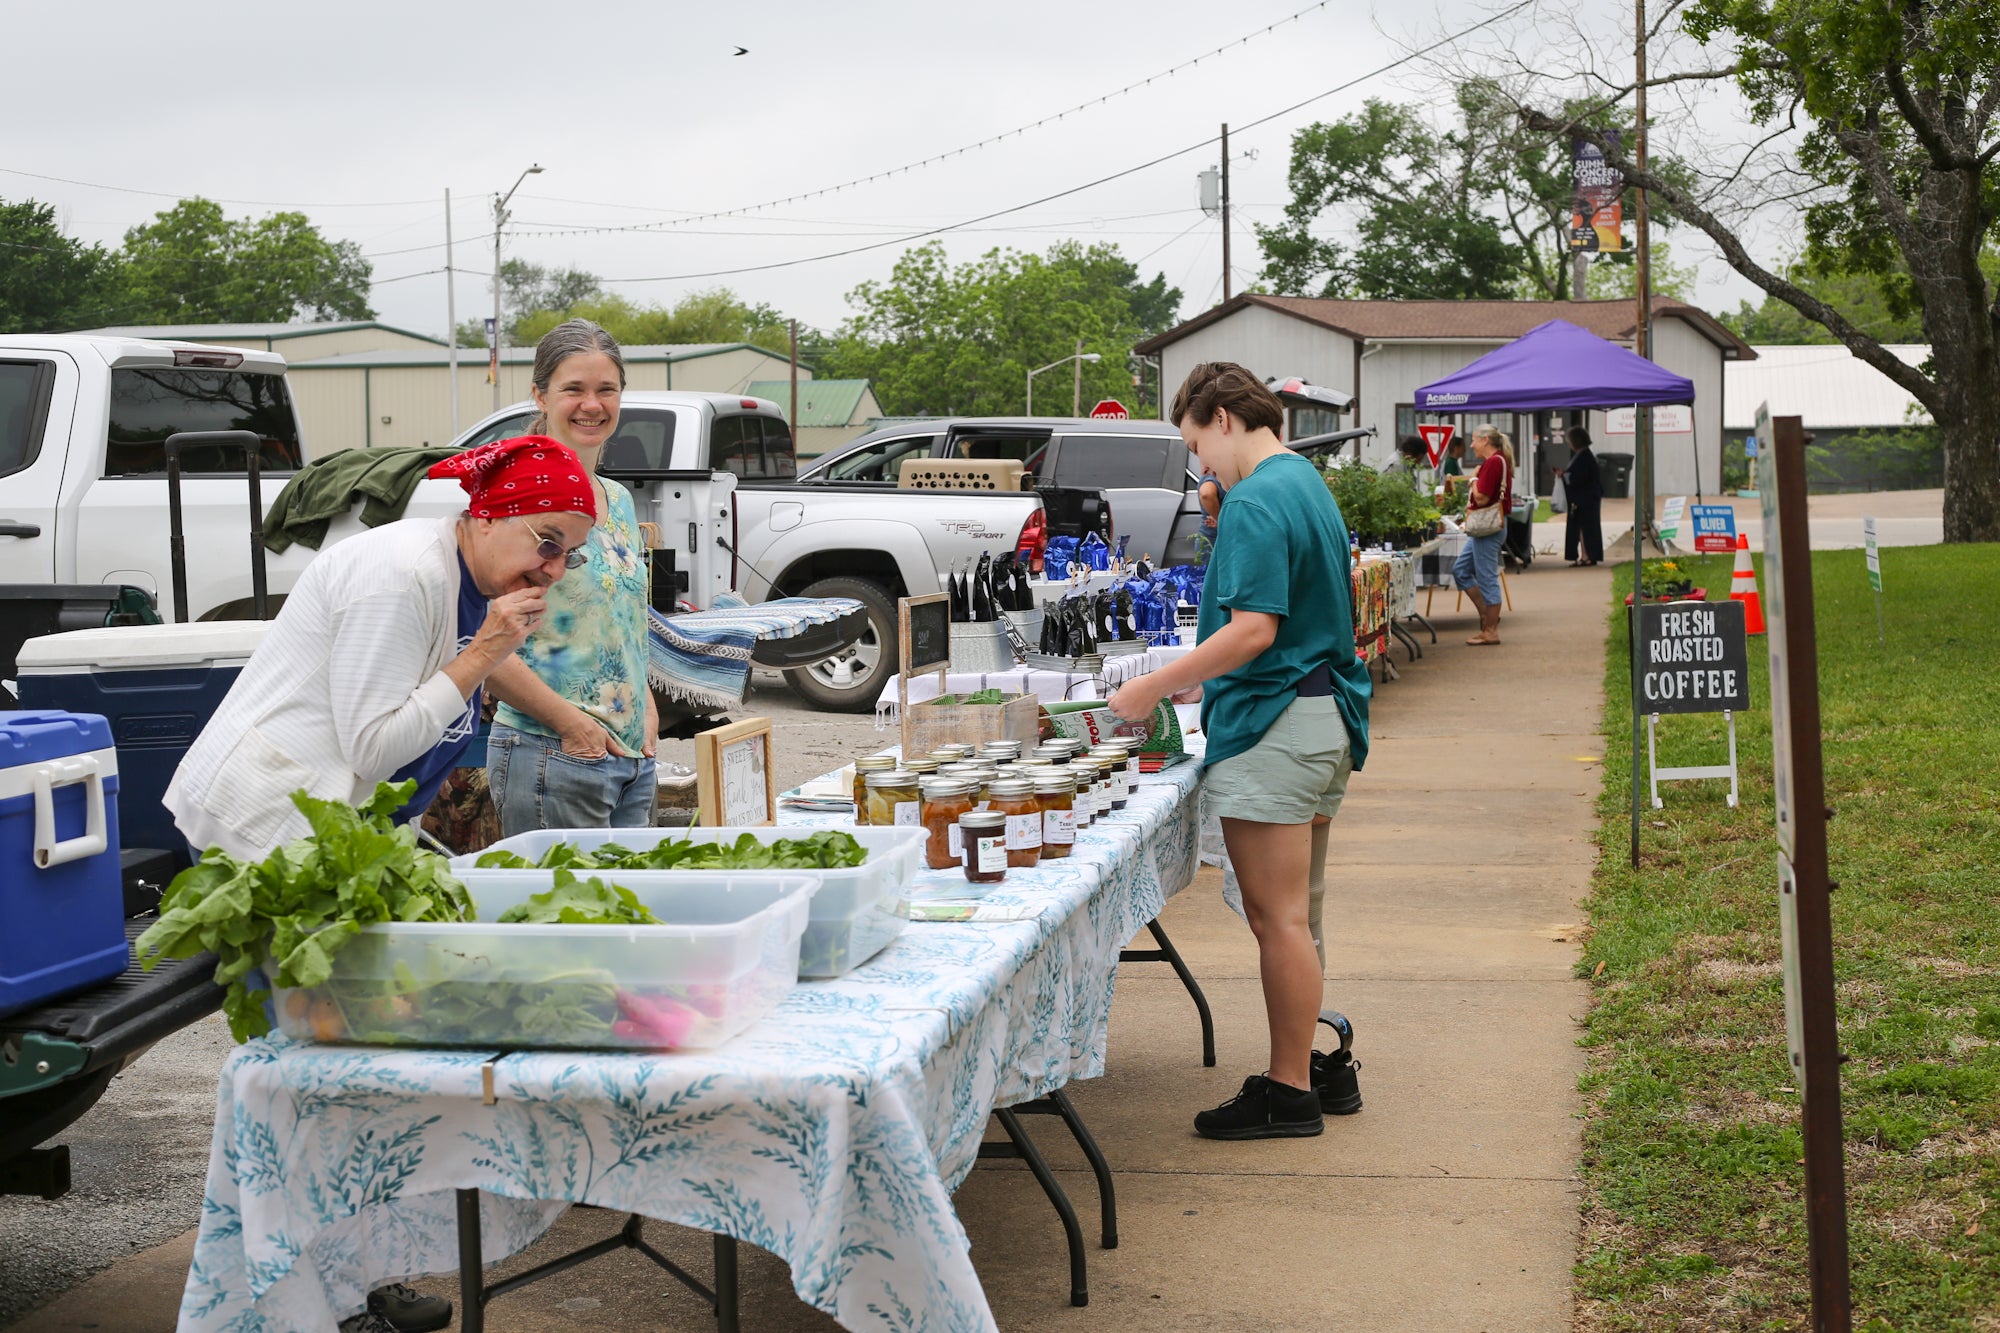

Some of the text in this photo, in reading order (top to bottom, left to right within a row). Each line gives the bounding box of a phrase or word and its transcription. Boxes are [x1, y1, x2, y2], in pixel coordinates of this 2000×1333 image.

[1575, 160, 1605, 169] SUMM
[1581, 178, 1612, 187] SERIES
[1426, 392, 1471, 404] Academy
[939, 521, 986, 535] TRD
[1700, 517, 1727, 531] OLIVER
[971, 532, 1007, 540] SPORT
[1661, 609, 1716, 637] FRESH
[1650, 637, 1724, 663] ROASTED
[1644, 669, 1738, 700] COFFEE
